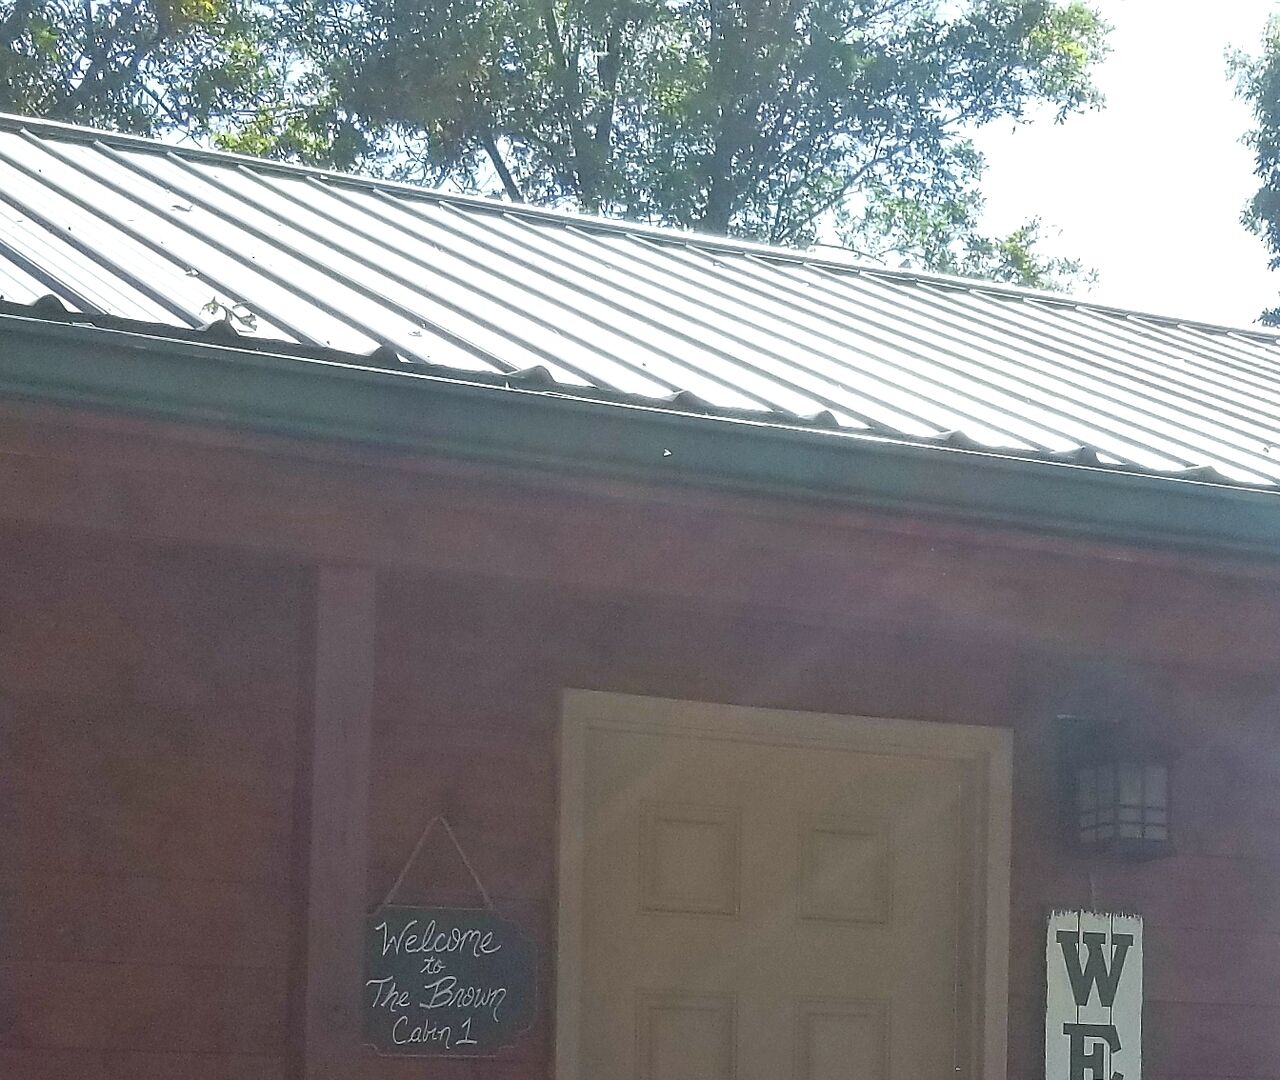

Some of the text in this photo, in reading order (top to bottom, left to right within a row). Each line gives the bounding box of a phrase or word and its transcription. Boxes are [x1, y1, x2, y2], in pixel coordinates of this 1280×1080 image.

[375, 919, 502, 957] Welcome
[420, 956, 446, 974] to
[365, 975, 507, 1023] The Brown
[392, 1015, 478, 1050] Cabin 1
